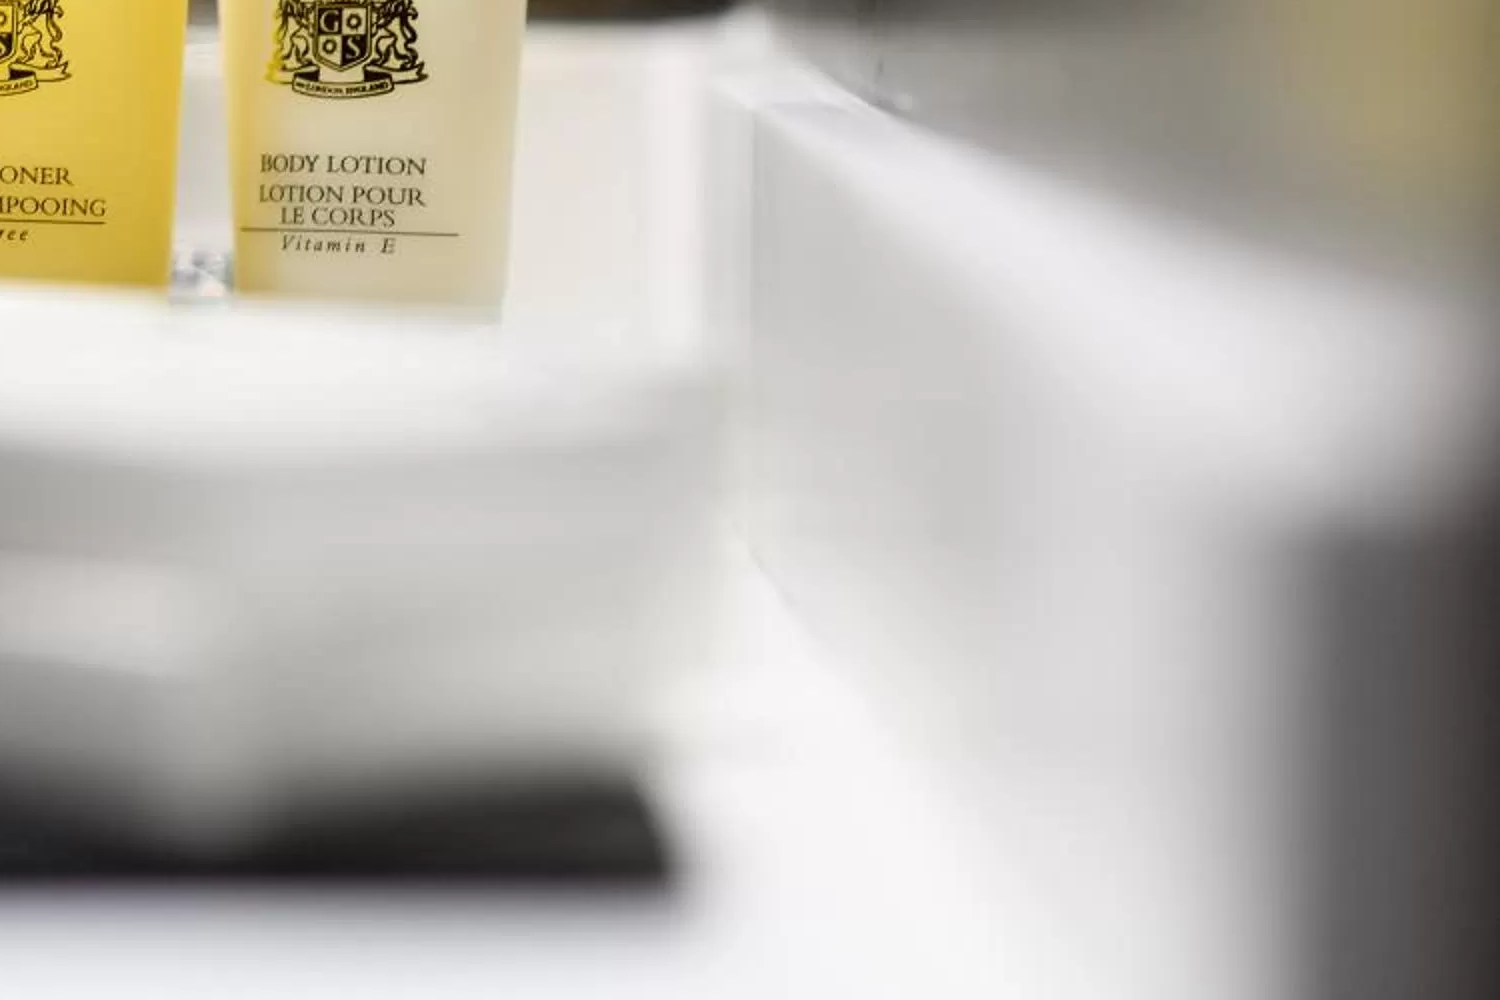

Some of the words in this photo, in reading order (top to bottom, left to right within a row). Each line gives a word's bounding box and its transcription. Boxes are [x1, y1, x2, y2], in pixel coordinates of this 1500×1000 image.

[319, 10, 340, 33] G
[346, 36, 361, 60] S
[260, 154, 320, 174] BODY
[327, 155, 427, 176] LOTION
[259, 183, 344, 204] LOTION
[353, 185, 428, 207] POUR
[280, 206, 305, 225] LE
[311, 206, 396, 228] CORPS
[281, 234, 366, 254] Vitamin
[381, 237, 397, 255] E
